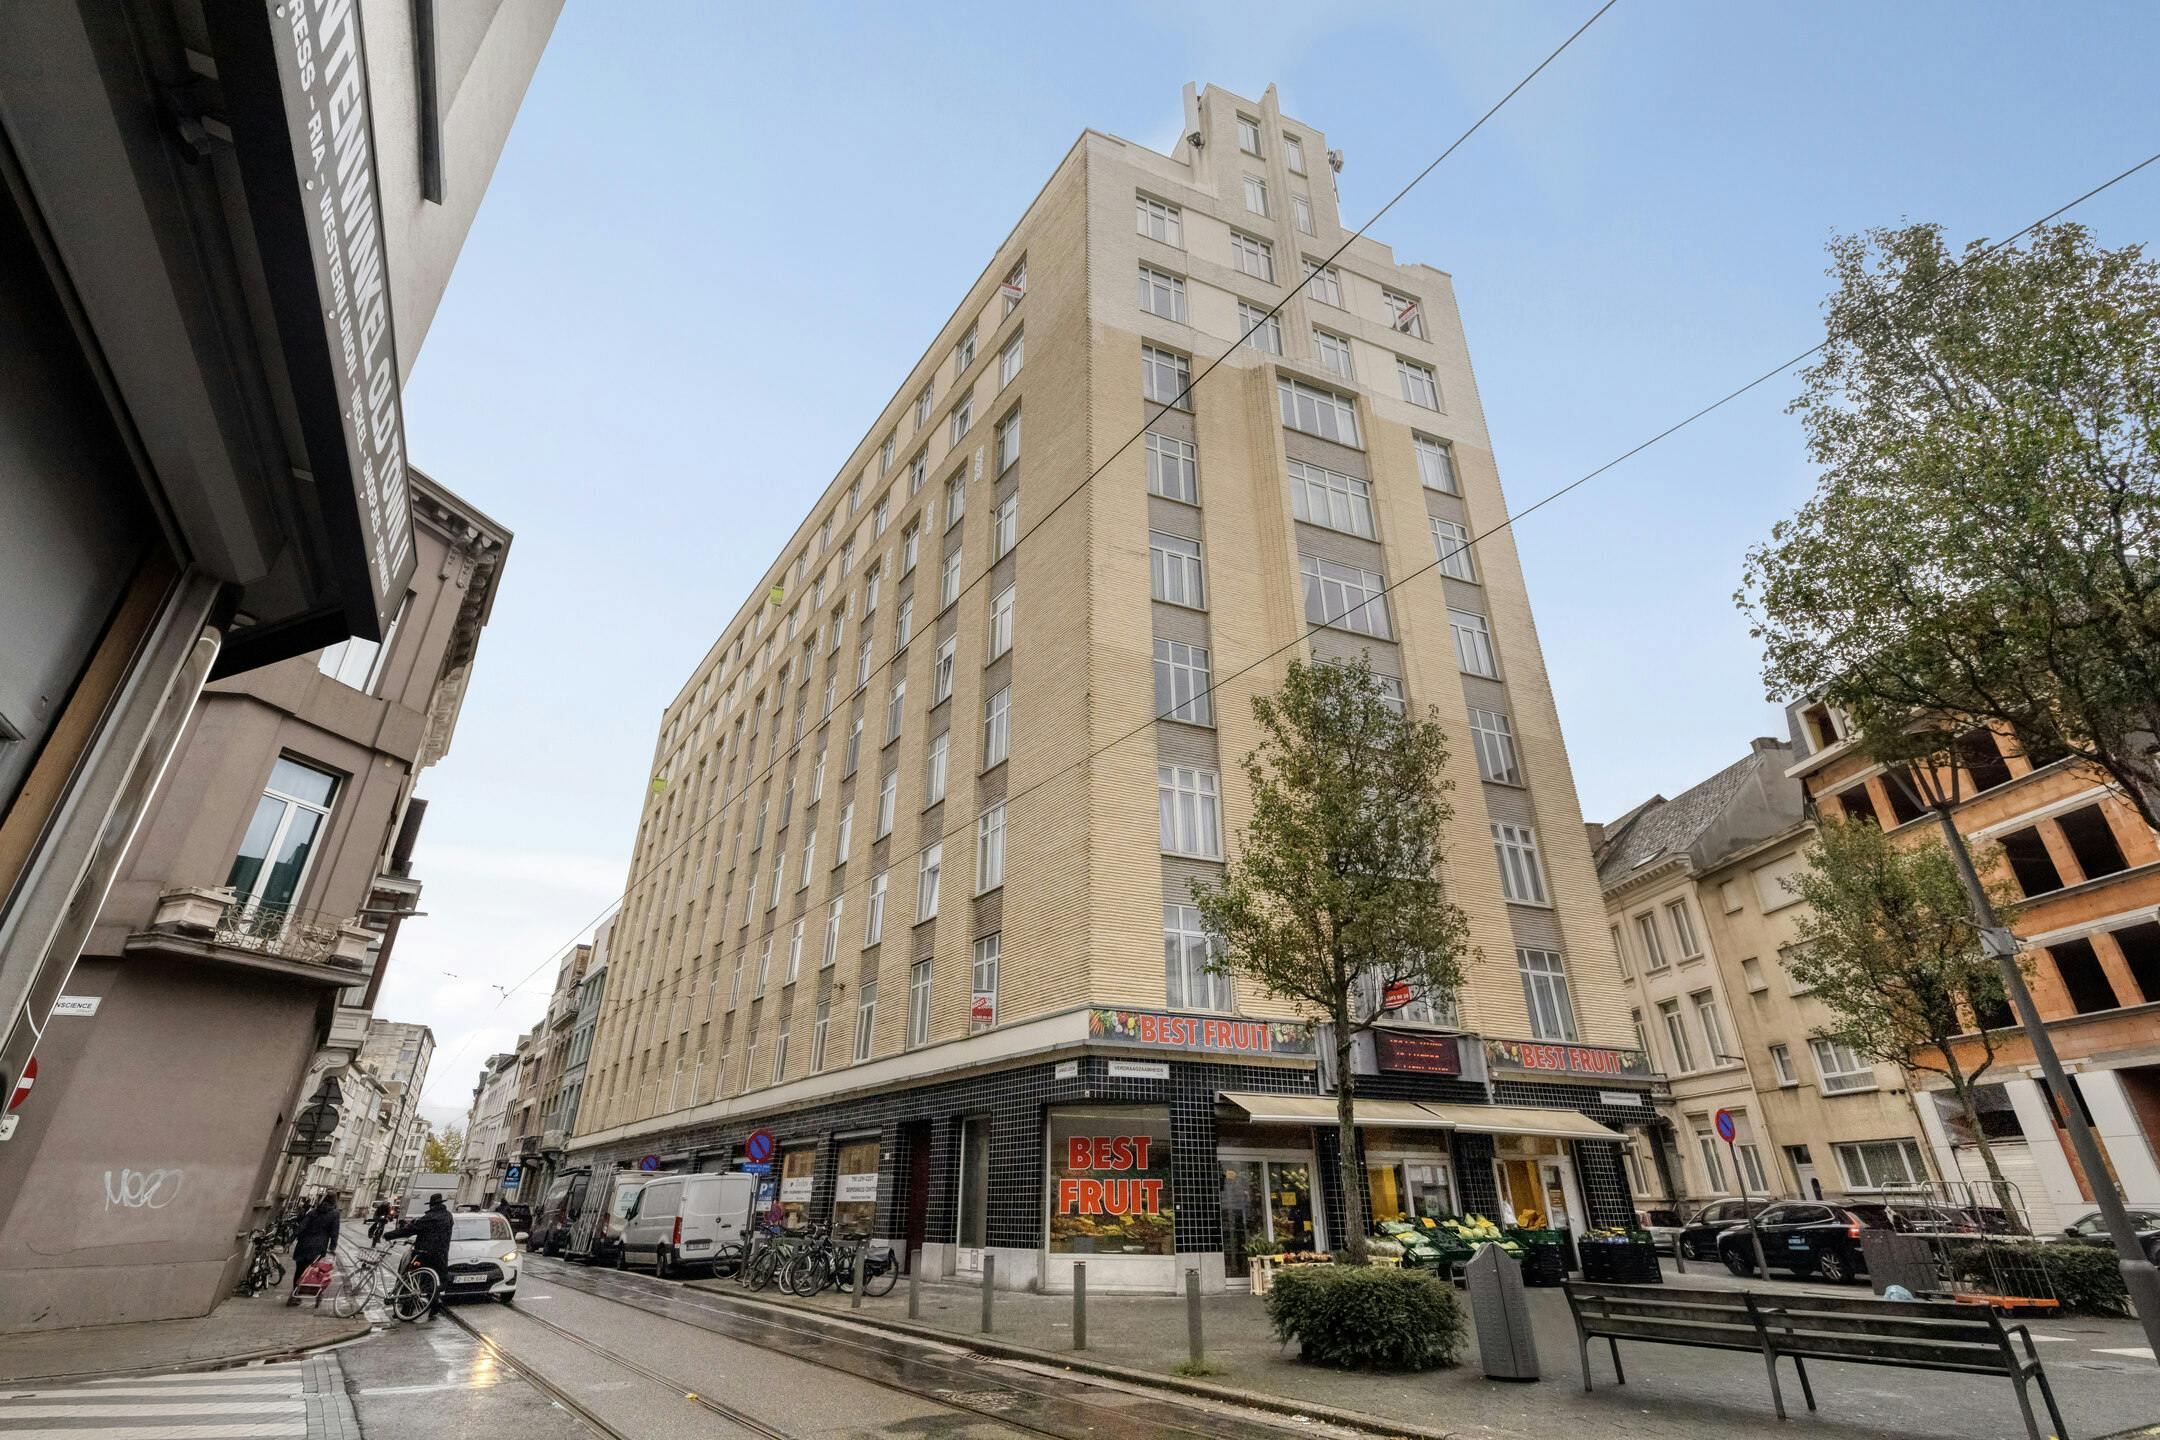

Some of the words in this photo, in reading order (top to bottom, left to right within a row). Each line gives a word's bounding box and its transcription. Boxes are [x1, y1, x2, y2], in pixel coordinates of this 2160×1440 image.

[307, 110, 326, 173] RIA
[320, 185, 348, 314] WESTERN
[339, 306, 358, 379] UNION
[351, 383, 367, 453] NICKEL
[368, 357, 395, 455] OLD
[380, 431, 407, 554] TOWN
[1140, 1014, 1198, 1046] BEST
[1202, 1019, 1272, 1052] FRUIT
[1519, 1043, 1567, 1070] BEST
[1568, 1047, 1622, 1075] FRUIT
[1068, 1135, 1153, 1171] BEST
[1059, 1178, 1164, 1216] FRUIT
